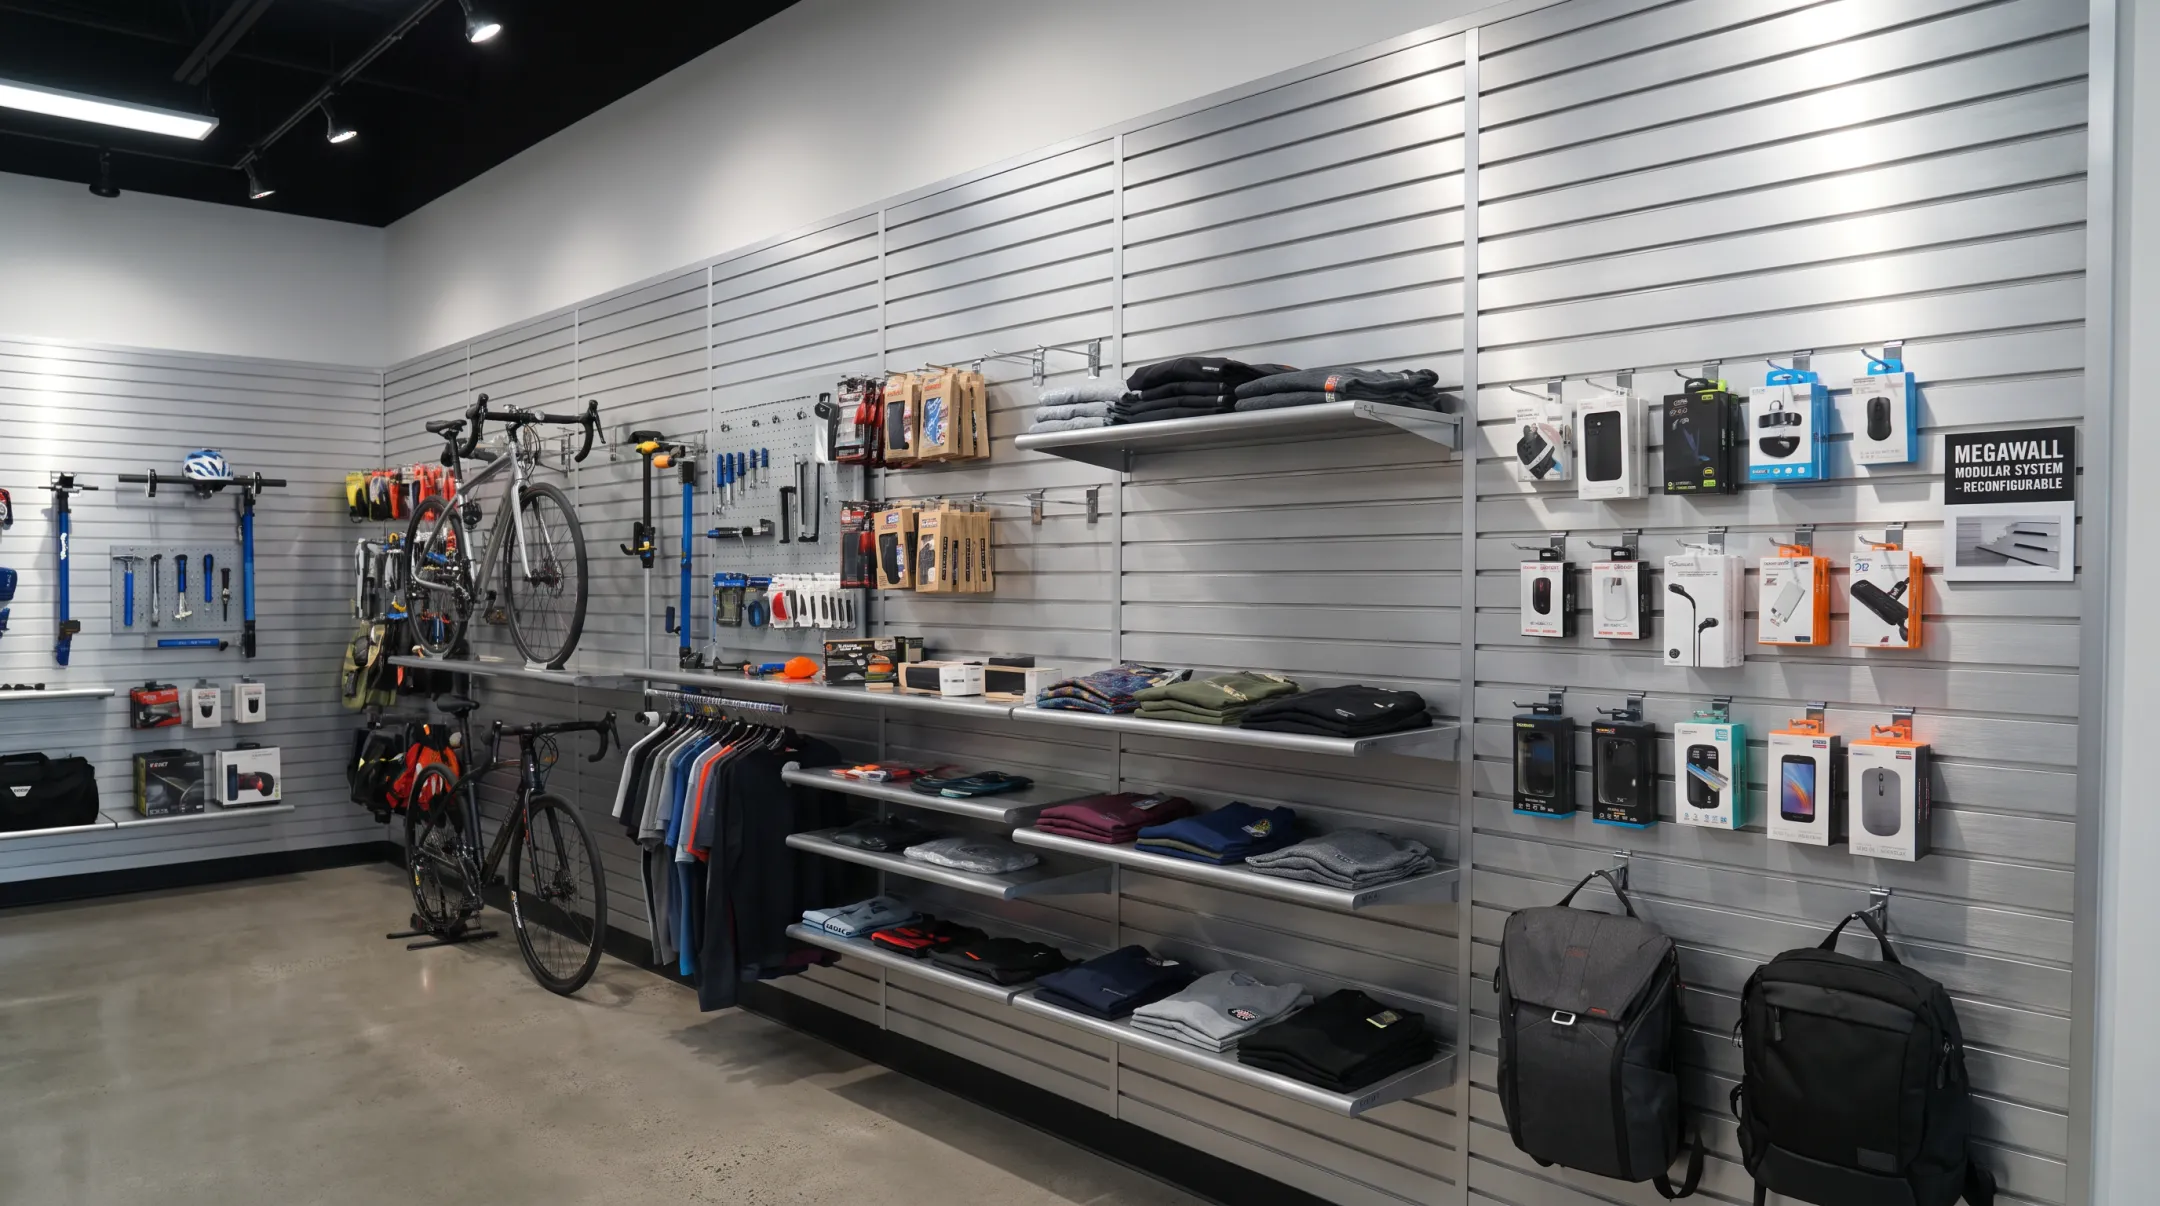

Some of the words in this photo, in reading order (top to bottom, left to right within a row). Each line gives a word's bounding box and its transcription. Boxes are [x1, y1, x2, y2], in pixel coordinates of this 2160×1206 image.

[1954, 439, 2064, 464] MEGAWALL
[1955, 465, 2010, 479] MODULAR
[2014, 462, 2063, 476] SYSTEM
